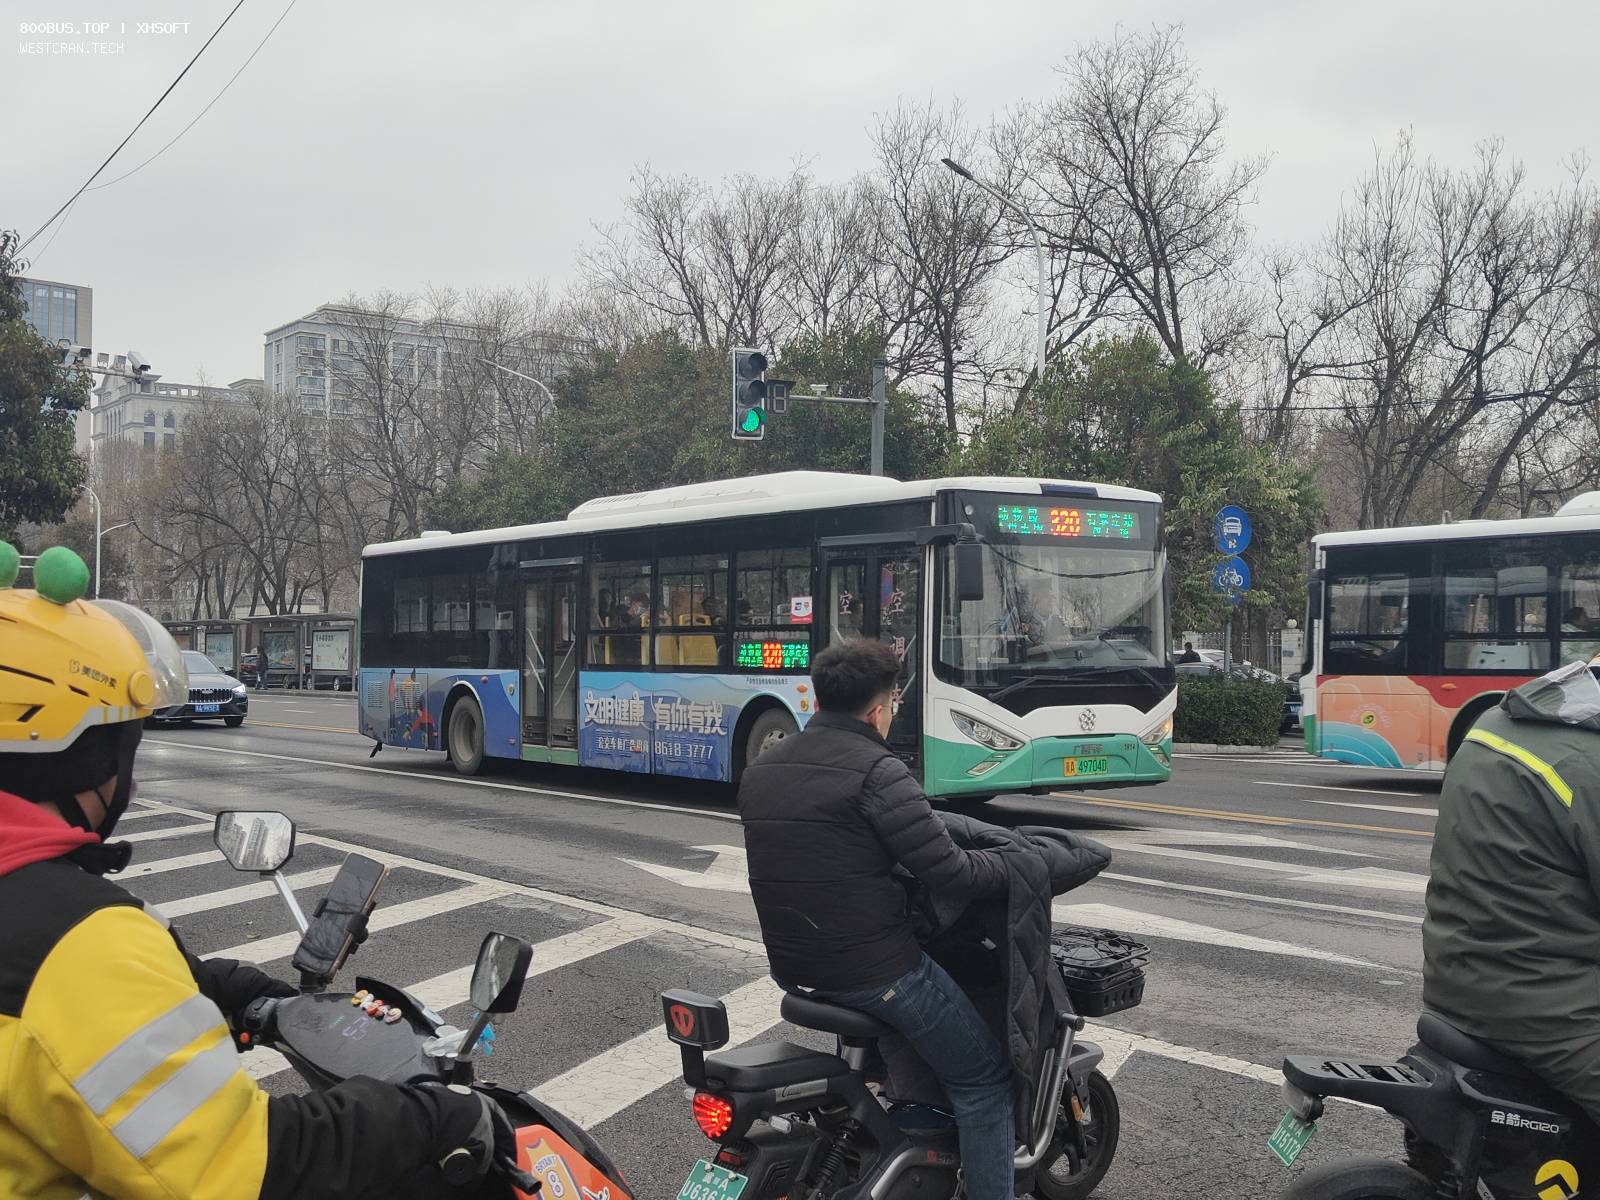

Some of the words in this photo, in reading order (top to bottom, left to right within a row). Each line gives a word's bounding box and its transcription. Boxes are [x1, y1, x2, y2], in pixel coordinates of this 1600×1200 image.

[584, 689, 648, 727] 文明健康
[651, 690, 728, 736] 有你有我
[687, 744, 714, 760] 3777
[1078, 759, 1107, 774] 49704D
[535, 1155, 558, 1174] BRYANT
[547, 1170, 564, 1198] 8
[682, 1180, 734, 1200] U636
